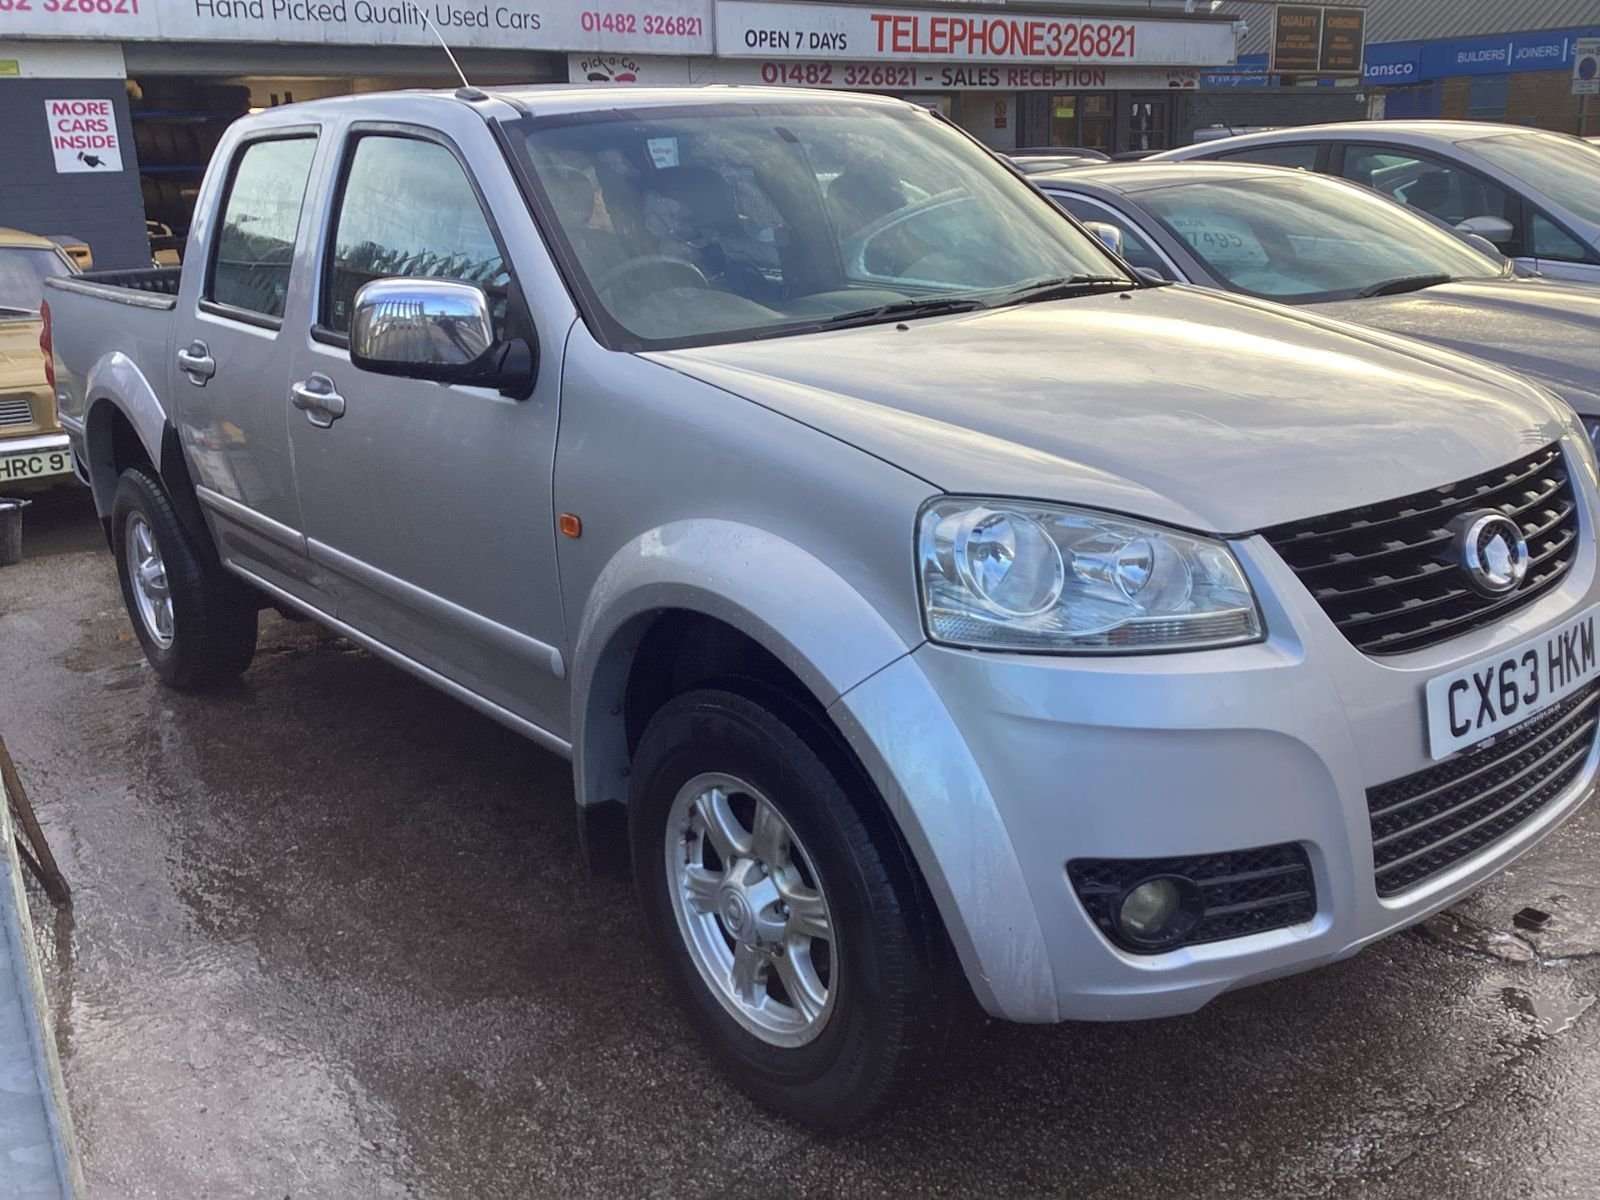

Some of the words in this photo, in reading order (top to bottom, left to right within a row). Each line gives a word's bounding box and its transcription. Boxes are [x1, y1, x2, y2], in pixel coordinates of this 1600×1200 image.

[195, 0, 263, 19] Hand
[272, 0, 347, 22] Picked
[354, 0, 431, 31] Quality
[436, 7, 489, 28] Used
[495, 8, 542, 31] Cars
[581, 11, 637, 33] 01482
[643, 14, 702, 36] 326821
[745, 29, 790, 49] OPEN
[795, 32, 804, 50] 7
[809, 33, 848, 50] DAYS
[870, 14, 1136, 58] TELEPHONE326821
[580, 55, 640, 73] Pick-a-Car
[1457, 49, 1505, 64] BUILDERS
[1515, 45, 1560, 60] JOINERS
[761, 62, 833, 85] 01482
[844, 67, 917, 86] 326821
[941, 67, 1000, 87] SALES
[1007, 68, 1106, 87] RECEPTION
[1364, 61, 1414, 77] Lansco
[52, 102, 109, 115] MORE
[57, 119, 109, 132] CARS
[54, 135, 116, 149] INSIDE
[0, 456, 43, 477] HRC
[49, 452, 72, 471] 9
[1448, 649, 1540, 738] CX63
[1547, 617, 1596, 693] HKM
